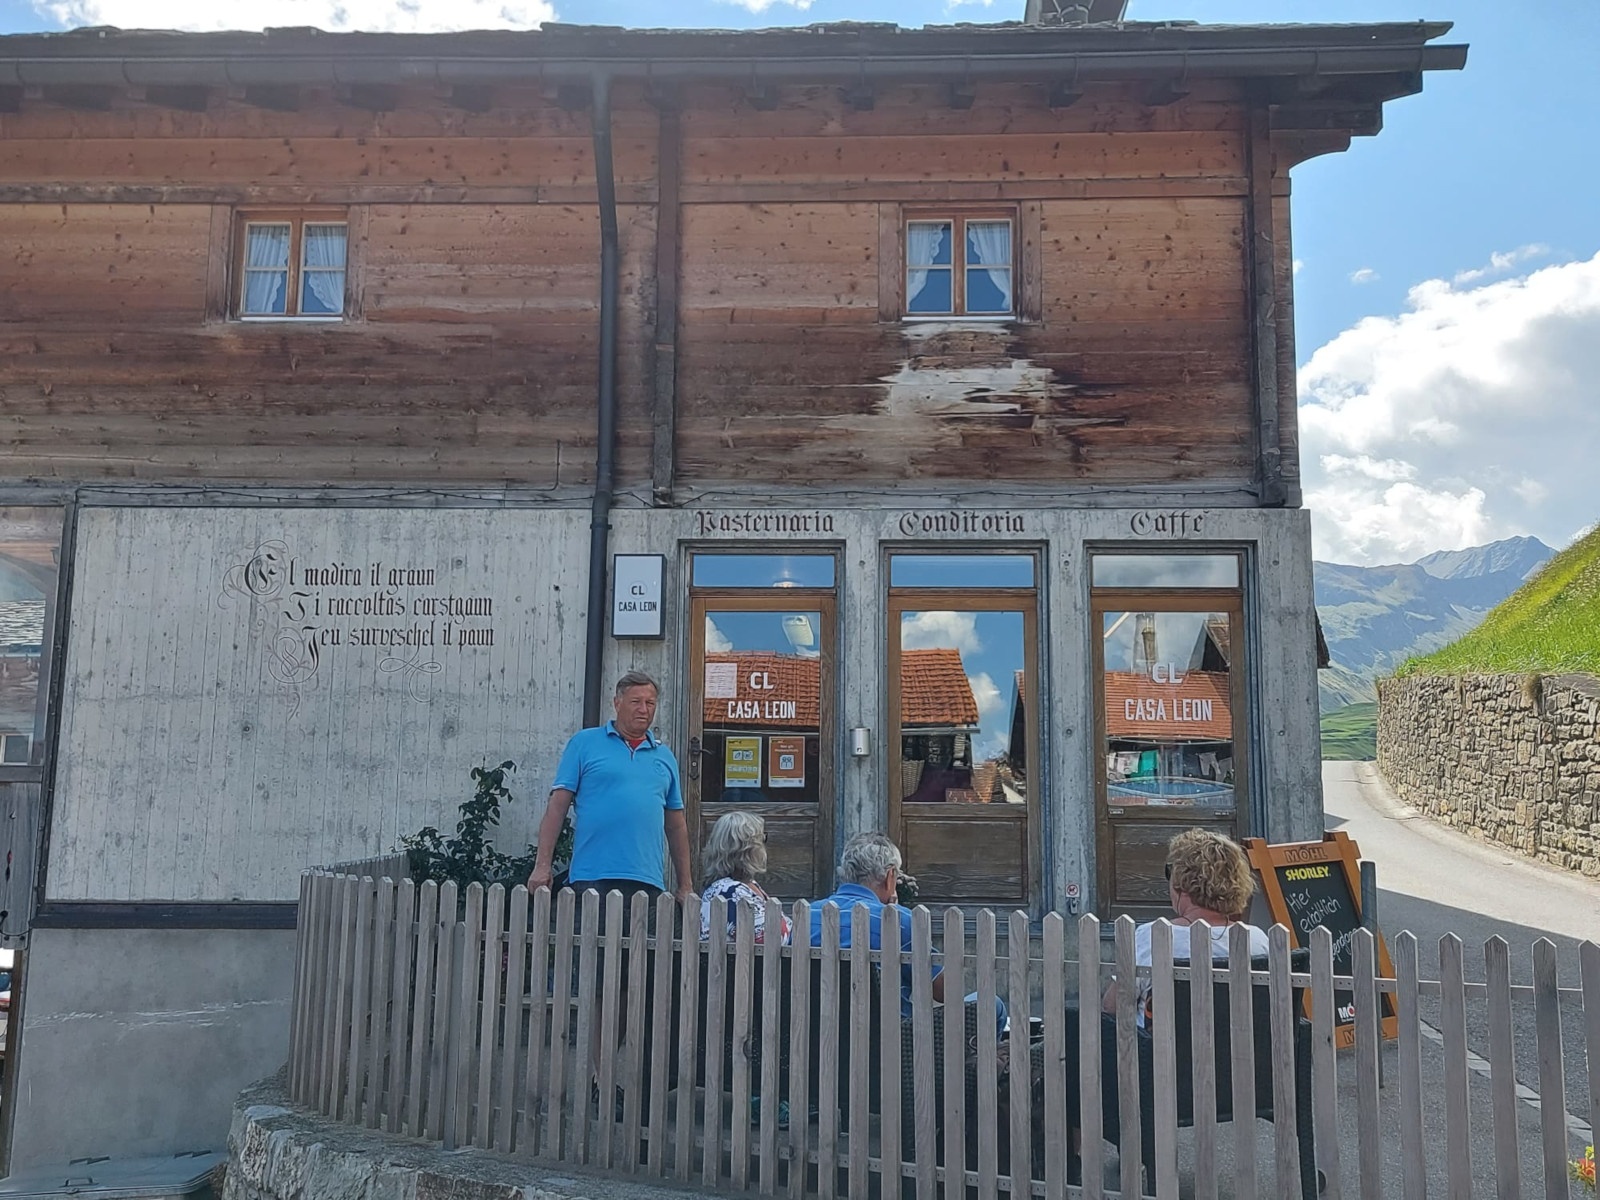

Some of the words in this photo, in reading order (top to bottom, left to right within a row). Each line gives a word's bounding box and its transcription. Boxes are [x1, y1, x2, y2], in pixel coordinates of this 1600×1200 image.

[695, 510, 834, 536] Pasternaria
[899, 510, 1025, 536] Conditoria
[304, 562, 362, 586] madira
[370, 561, 382, 586] il
[387, 567, 435, 595] graun
[631, 585, 645, 595] CL
[328, 592, 405, 616] raccoltas
[618, 601, 637, 612] CASA
[639, 601, 657, 612] LEON
[442, 621, 453, 646] il
[457, 628, 495, 653] paun
[750, 672, 774, 690] CL
[1152, 661, 1183, 684] CL
[728, 701, 760, 719] CASA
[765, 701, 796, 719] LEON
[1125, 699, 1167, 721] CASA
[1173, 699, 1212, 721] LEON
[1285, 865, 1329, 881] SHORLEY
[1285, 888, 1311, 915] Hier
